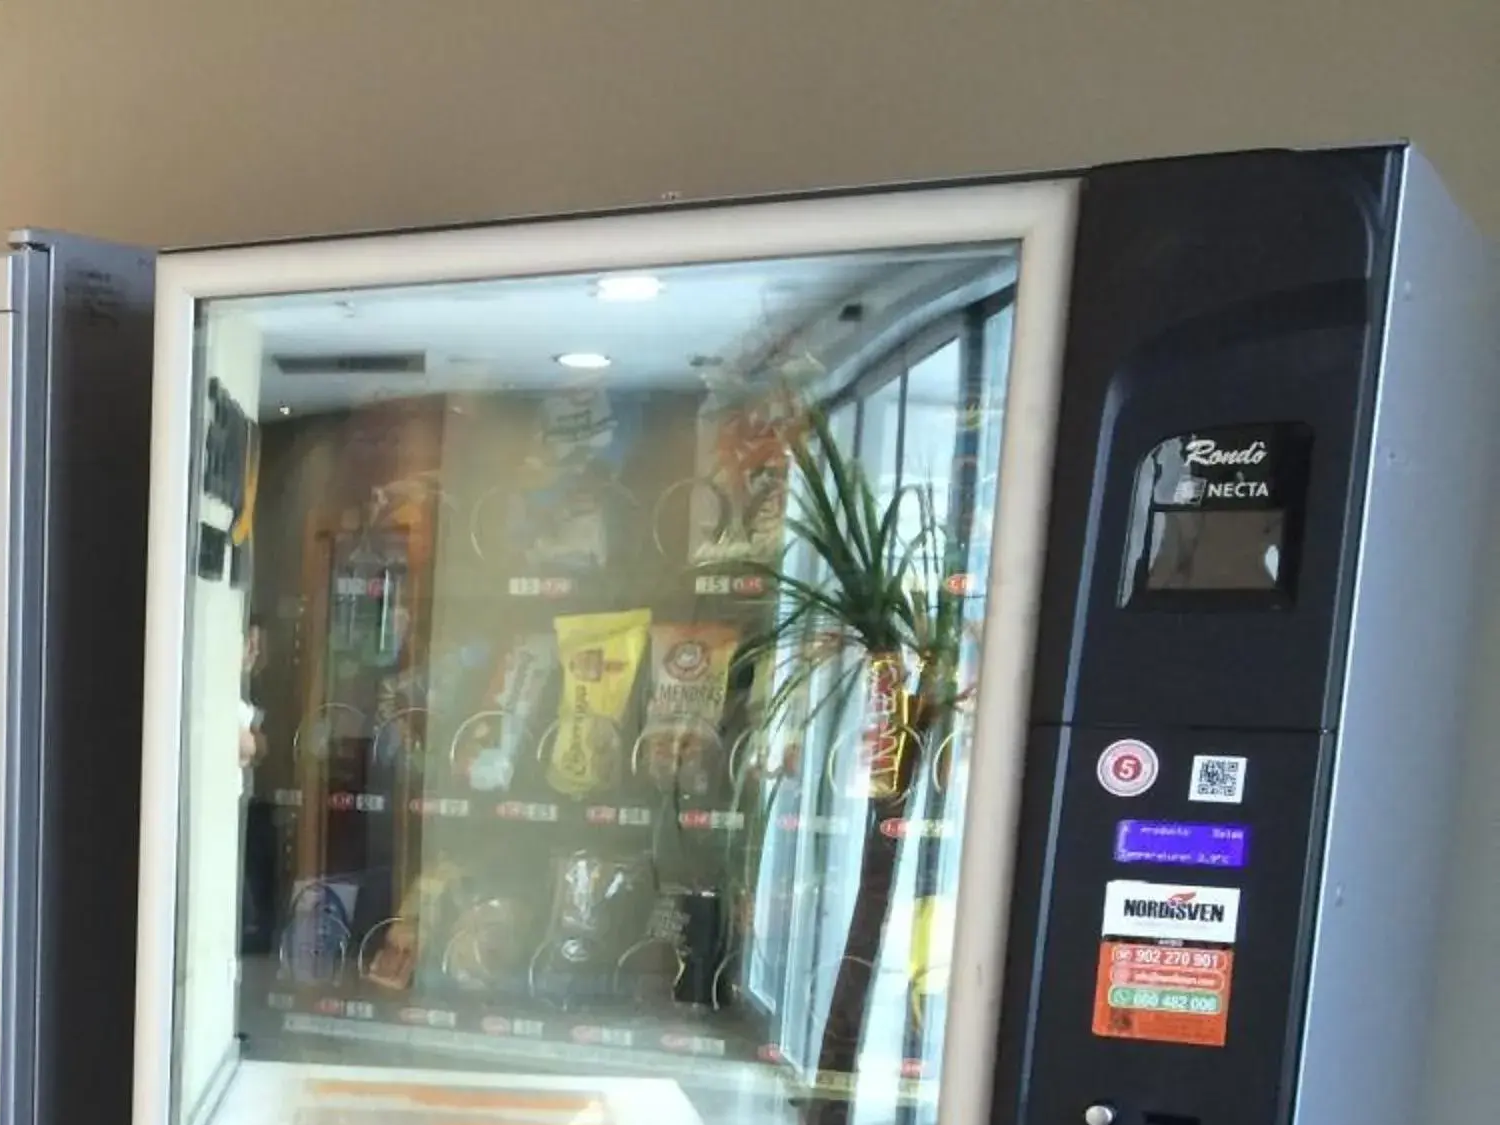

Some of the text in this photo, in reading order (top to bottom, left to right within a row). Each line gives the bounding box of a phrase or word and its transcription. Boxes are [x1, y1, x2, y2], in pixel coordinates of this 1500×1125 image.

[1206, 481, 1269, 499] NECTA
[1118, 758, 1138, 780] 5
[1135, 949, 1219, 969] 902 270 901
